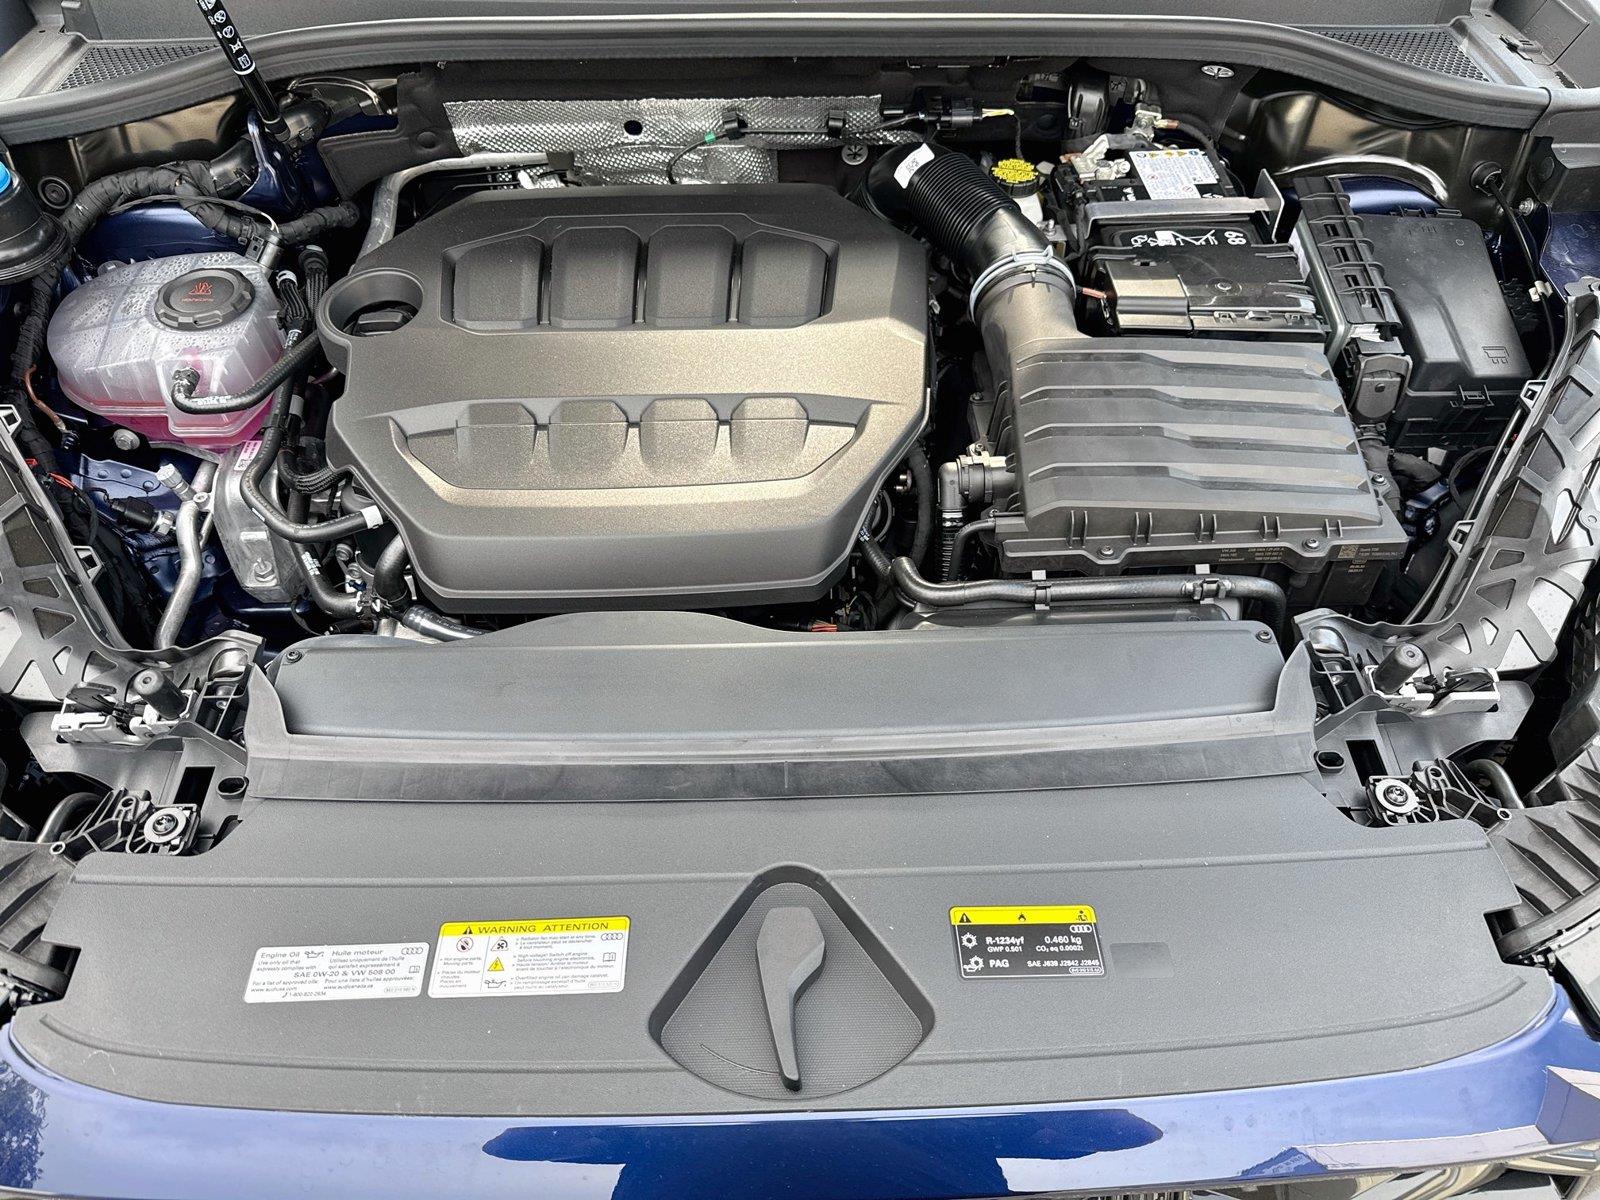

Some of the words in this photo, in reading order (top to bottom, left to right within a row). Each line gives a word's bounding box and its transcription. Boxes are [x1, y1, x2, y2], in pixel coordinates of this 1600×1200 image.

[543, 923, 608, 932] ATTENTION
[985, 936, 1024, 945] R-1234yf
[1071, 935, 1082, 945] kg
[989, 959, 1009, 968] PAG
